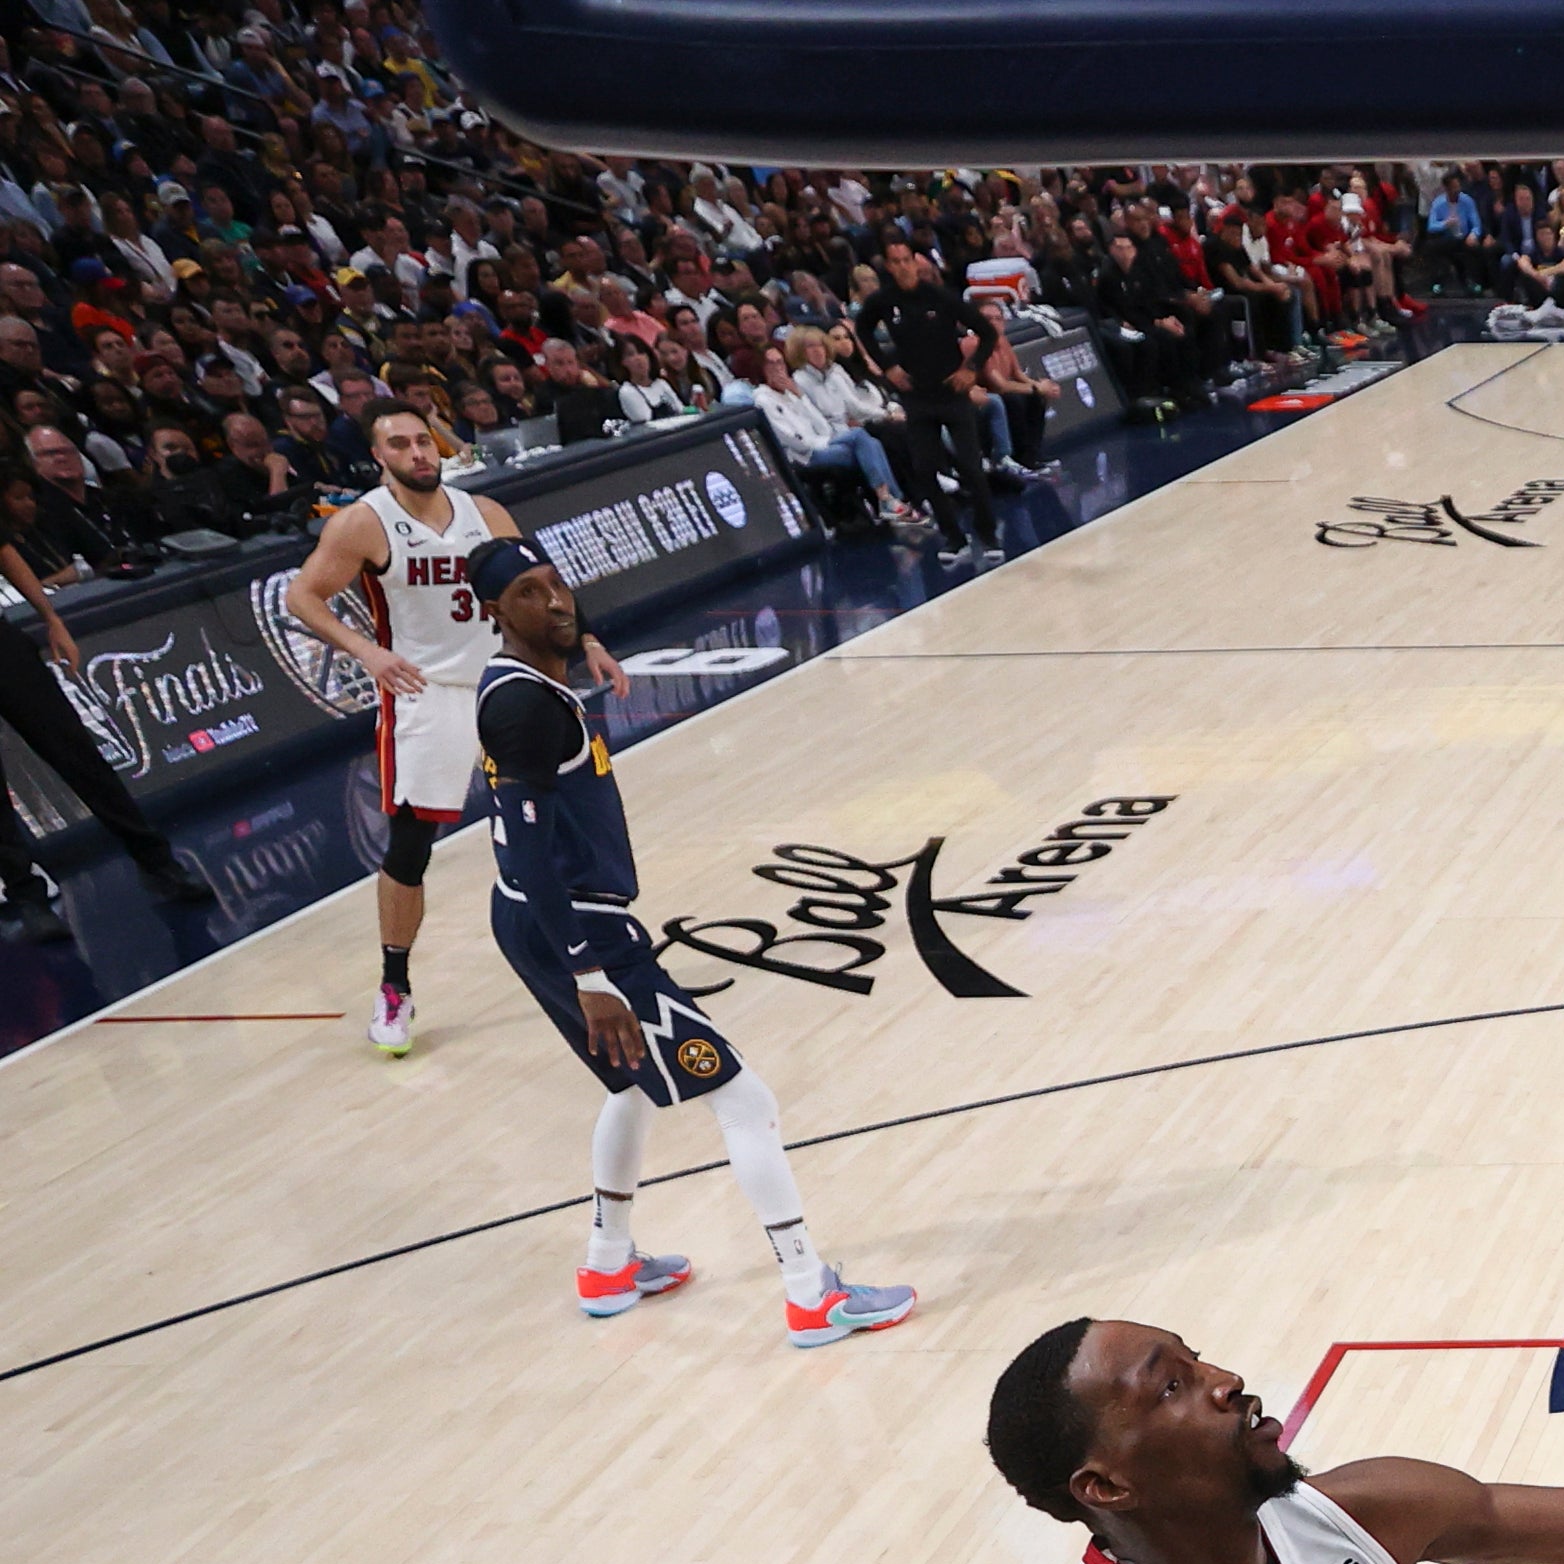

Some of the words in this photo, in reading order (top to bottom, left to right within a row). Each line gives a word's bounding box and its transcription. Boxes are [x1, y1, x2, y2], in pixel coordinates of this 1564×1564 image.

[407, 556, 470, 586] HEA
[1315, 496, 1458, 548] Ball
[87, 626, 264, 778] Finals
[652, 842, 930, 997] Ball
[933, 793, 1179, 921] Arena
